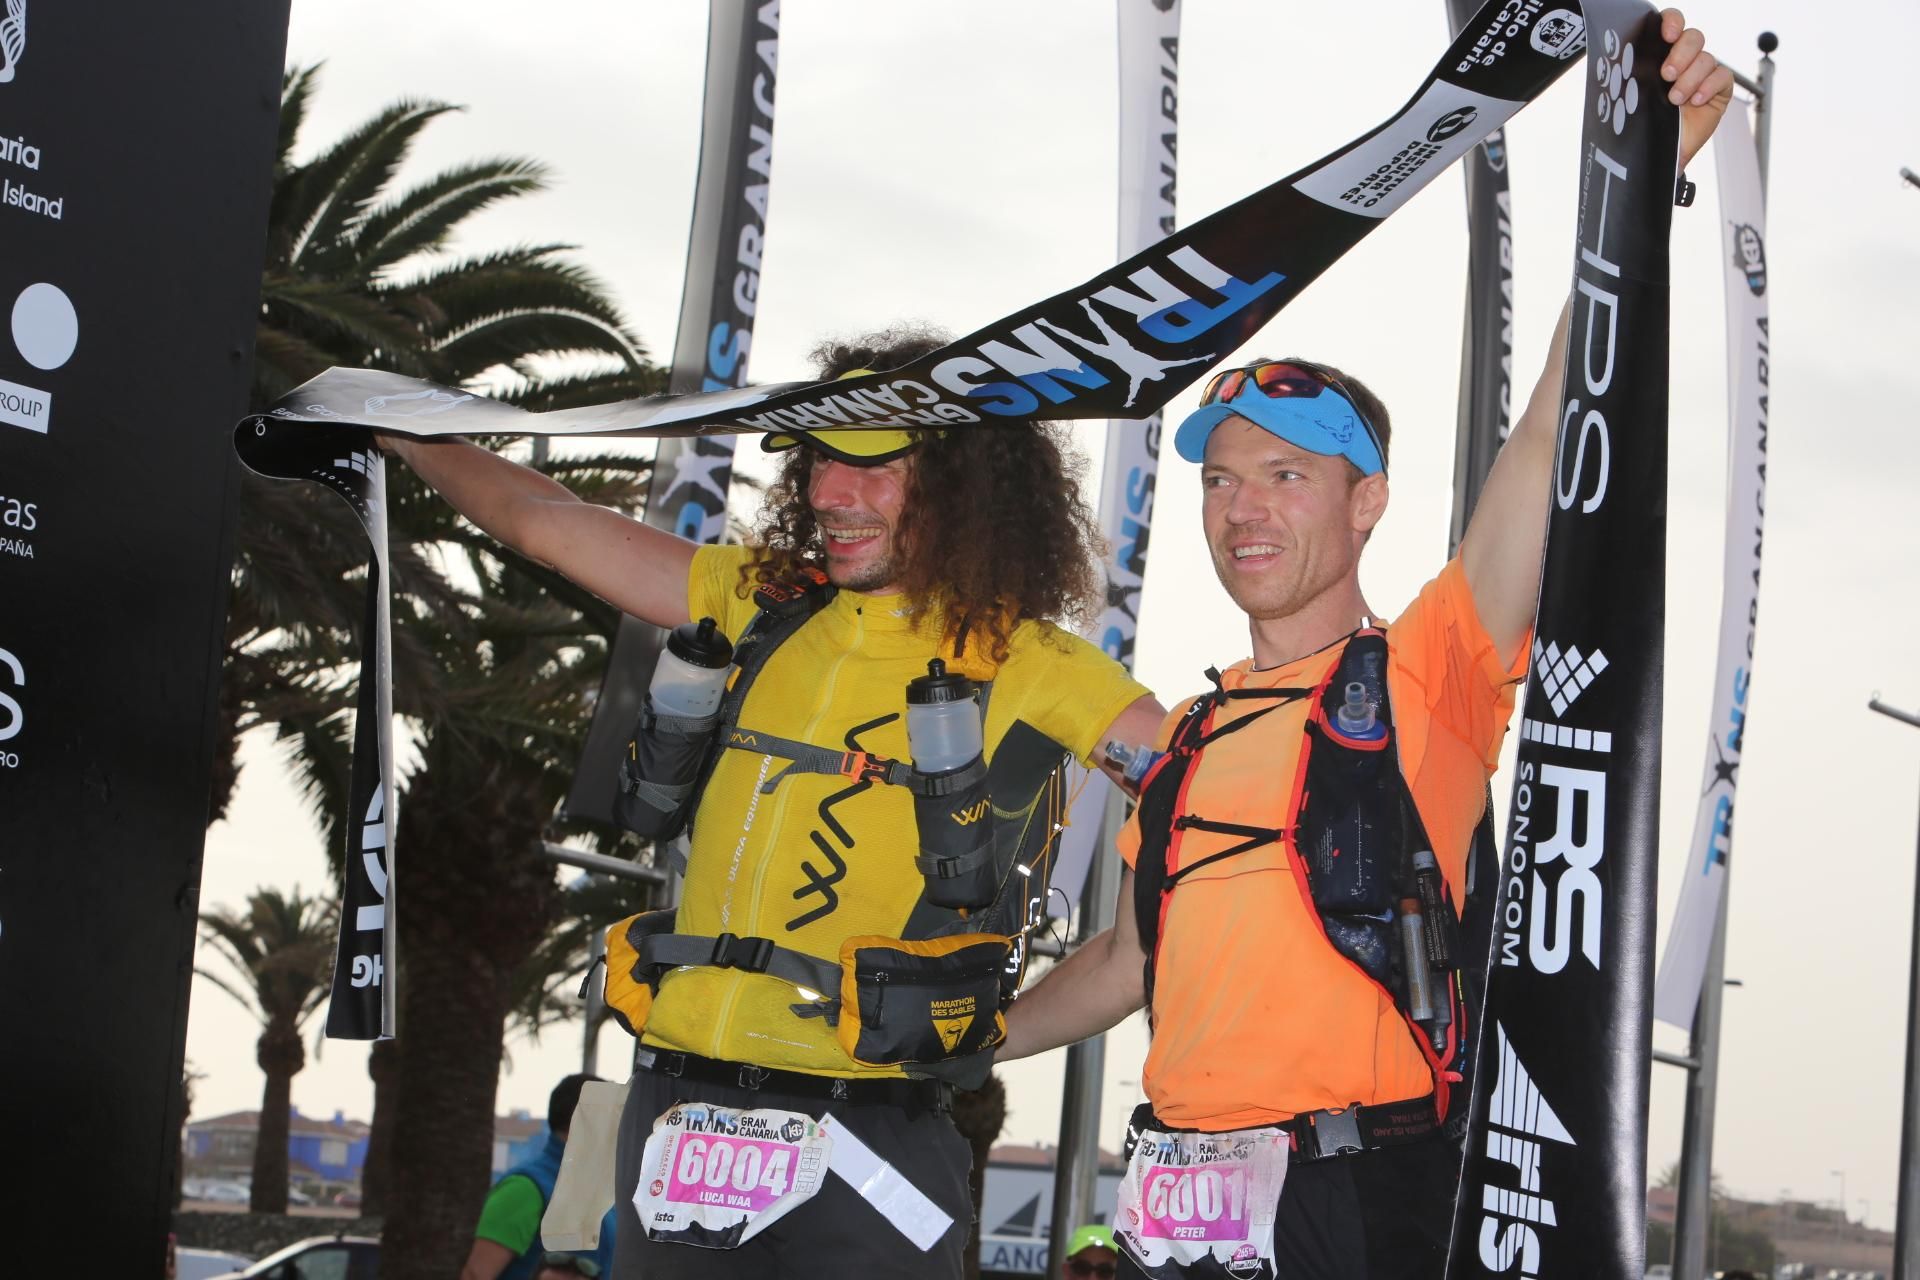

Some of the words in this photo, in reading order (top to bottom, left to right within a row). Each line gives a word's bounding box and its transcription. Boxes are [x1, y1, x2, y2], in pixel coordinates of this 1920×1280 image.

[1456, 0, 1522, 73] Canaria
[1481, 41, 1506, 66] de
[1339, 140, 1422, 201] DEPORTES
[1363, 145, 1442, 208] INSTITUTO
[1370, 143, 1432, 191] INSULAR
[3, 178, 63, 220] Island
[1556, 147, 1628, 514] HPS
[736, 379, 940, 433] CANARIA
[728, 836, 747, 881] ULTRA
[743, 754, 773, 832] EQUIPMEN
[1501, 760, 1534, 967] SONOCOM
[931, 996, 975, 1009] MARATHON
[931, 1008, 947, 1017] DES
[948, 1004, 976, 1016] SABLES
[739, 1126, 780, 1141] CANARIA
[741, 1116, 767, 1129] GRAN
[677, 1138, 792, 1197] 6004
[699, 1191, 725, 1205] LUCA
[727, 1193, 751, 1208] WAA
[1147, 1169, 1244, 1222] 6001
[1173, 1226, 1206, 1238] PETER
